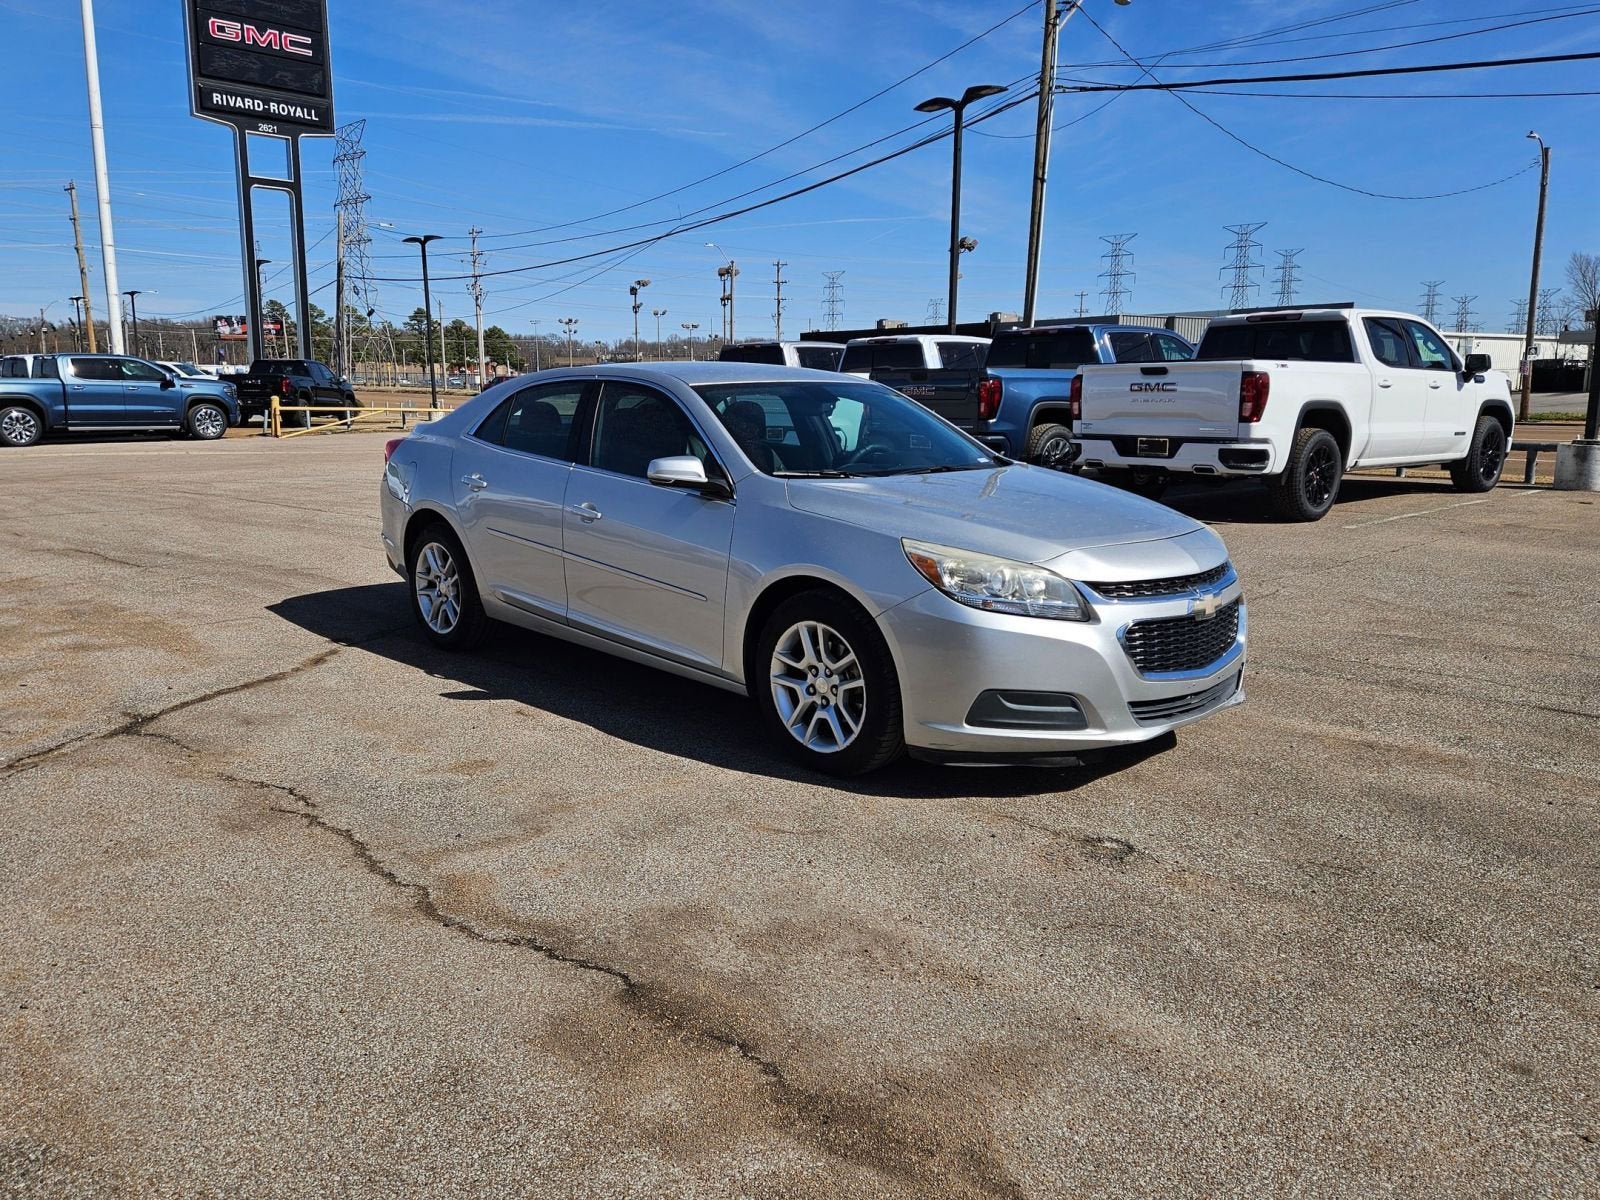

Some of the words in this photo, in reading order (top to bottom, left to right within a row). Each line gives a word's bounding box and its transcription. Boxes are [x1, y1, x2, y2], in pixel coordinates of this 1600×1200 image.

[208, 17, 313, 57] GMC
[212, 93, 319, 121] RIVARD-ROYALL
[258, 123, 278, 134] 2621
[902, 385, 936, 396] GMC
[1130, 382, 1178, 392] GMC
